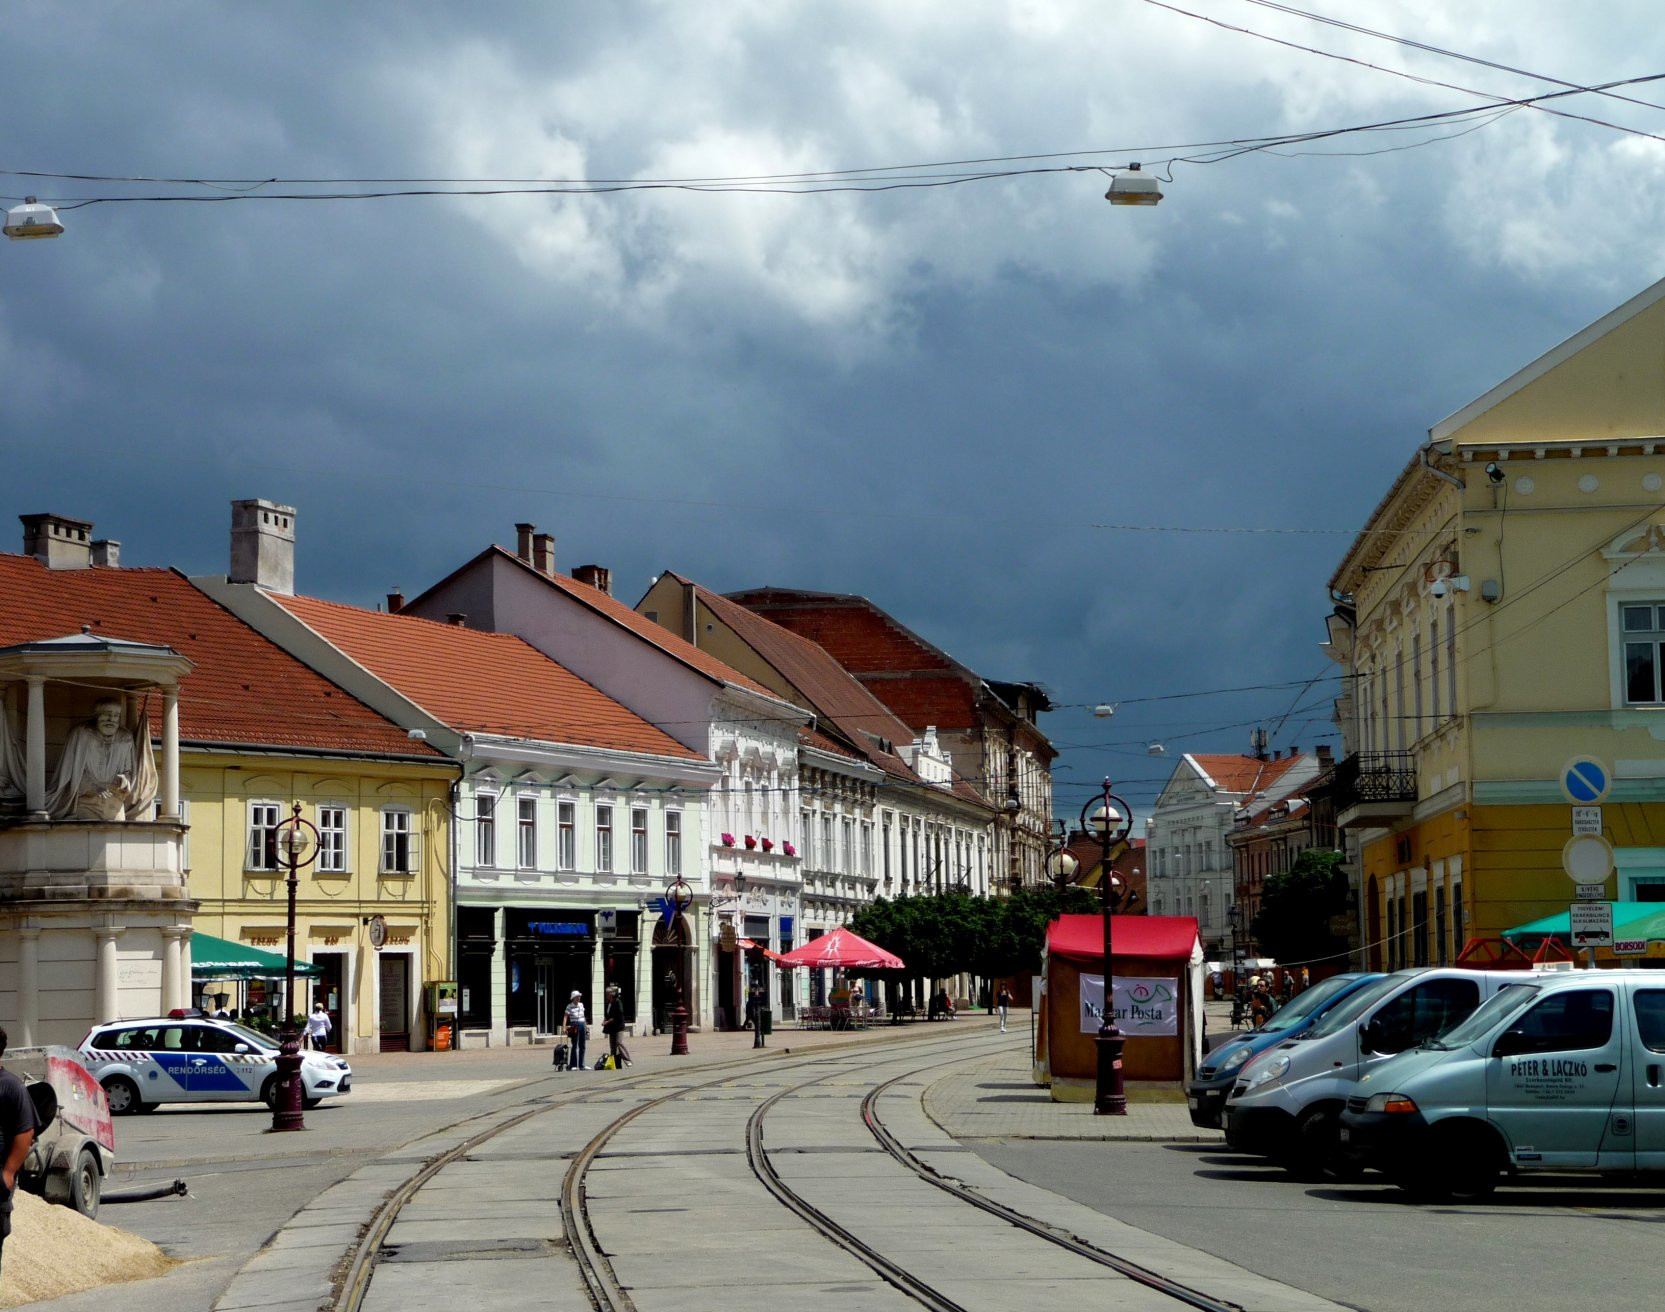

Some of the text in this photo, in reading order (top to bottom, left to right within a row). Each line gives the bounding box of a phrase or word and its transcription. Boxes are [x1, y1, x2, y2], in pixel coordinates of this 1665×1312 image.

[1615, 941, 1646, 951] BORSODI
[1130, 1004, 1163, 1020] Posta
[168, 1064, 226, 1074] RENDŐRSÉG
[1511, 1058, 1588, 1077] PÉTER & LACZKÓ
